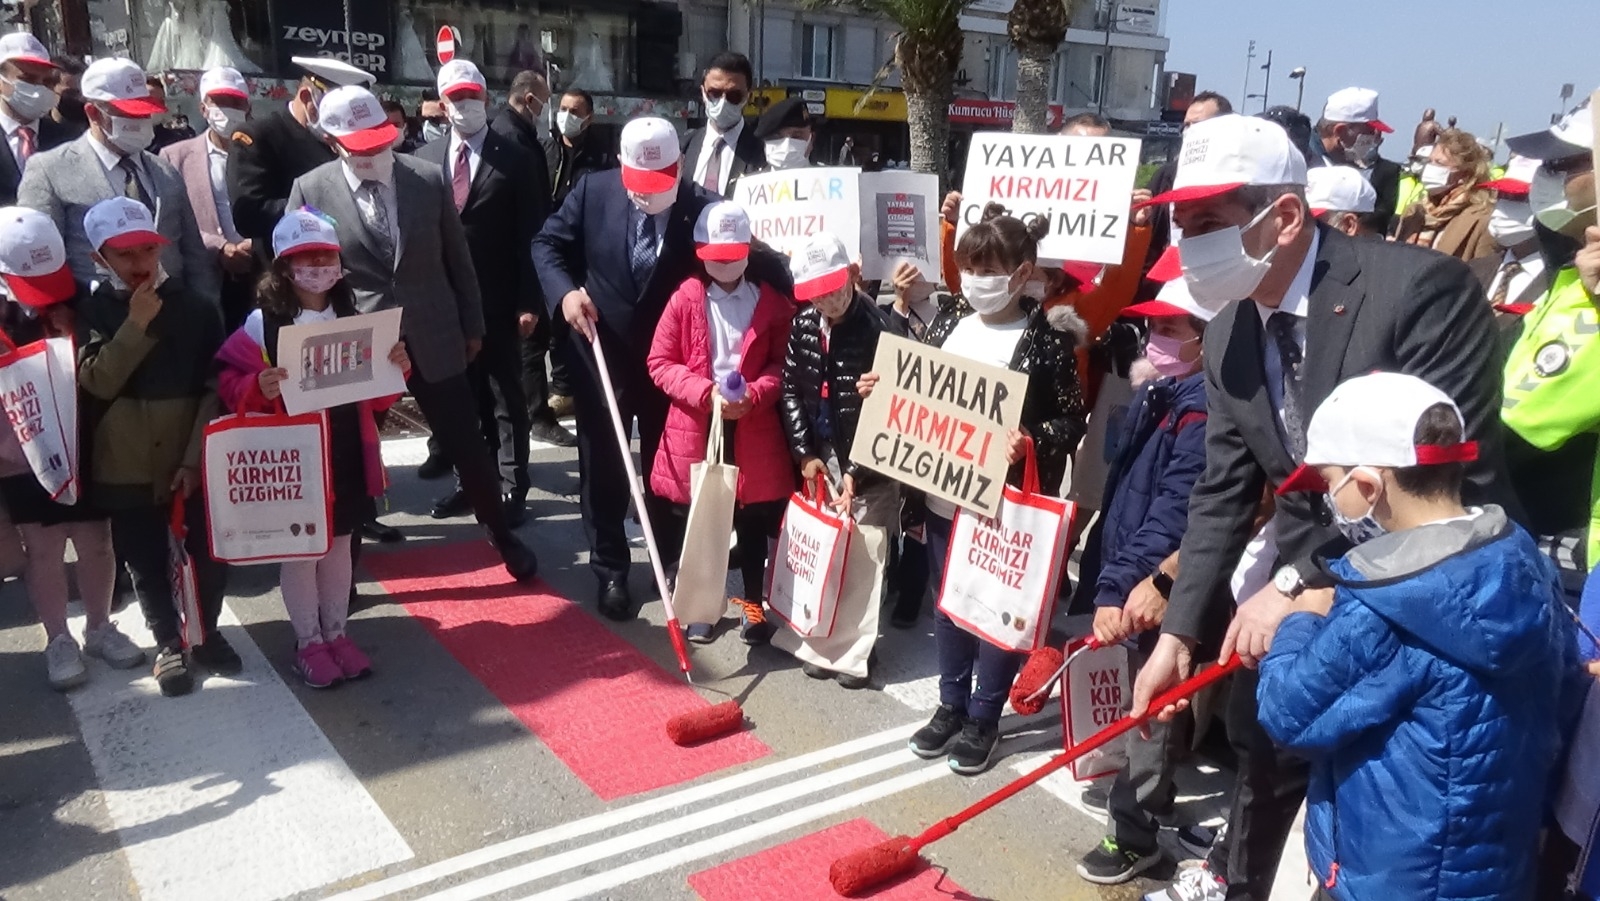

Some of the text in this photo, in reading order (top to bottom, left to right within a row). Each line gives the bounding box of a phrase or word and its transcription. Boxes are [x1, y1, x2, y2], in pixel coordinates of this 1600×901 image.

[283, 25, 385, 51] zeynep
[948, 103, 1016, 118] Kumrucu Hüs
[982, 142, 1127, 169] YAYALAR
[747, 177, 843, 206] YAYALAR
[989, 174, 1098, 202] KIRMIZI
[751, 214, 824, 239] IRMIZI
[896, 348, 1009, 426] YAYALAR
[886, 394, 993, 468] KIRMIZI
[226, 448, 301, 467] YAYALAR
[228, 465, 302, 486] KIRMIZI
[871, 432, 992, 510] ÇİZGİMİZ
[229, 484, 304, 505] ÇİZGİMİZ
[1088, 667, 1120, 687] YAY
[1090, 686, 1121, 707] KIR
